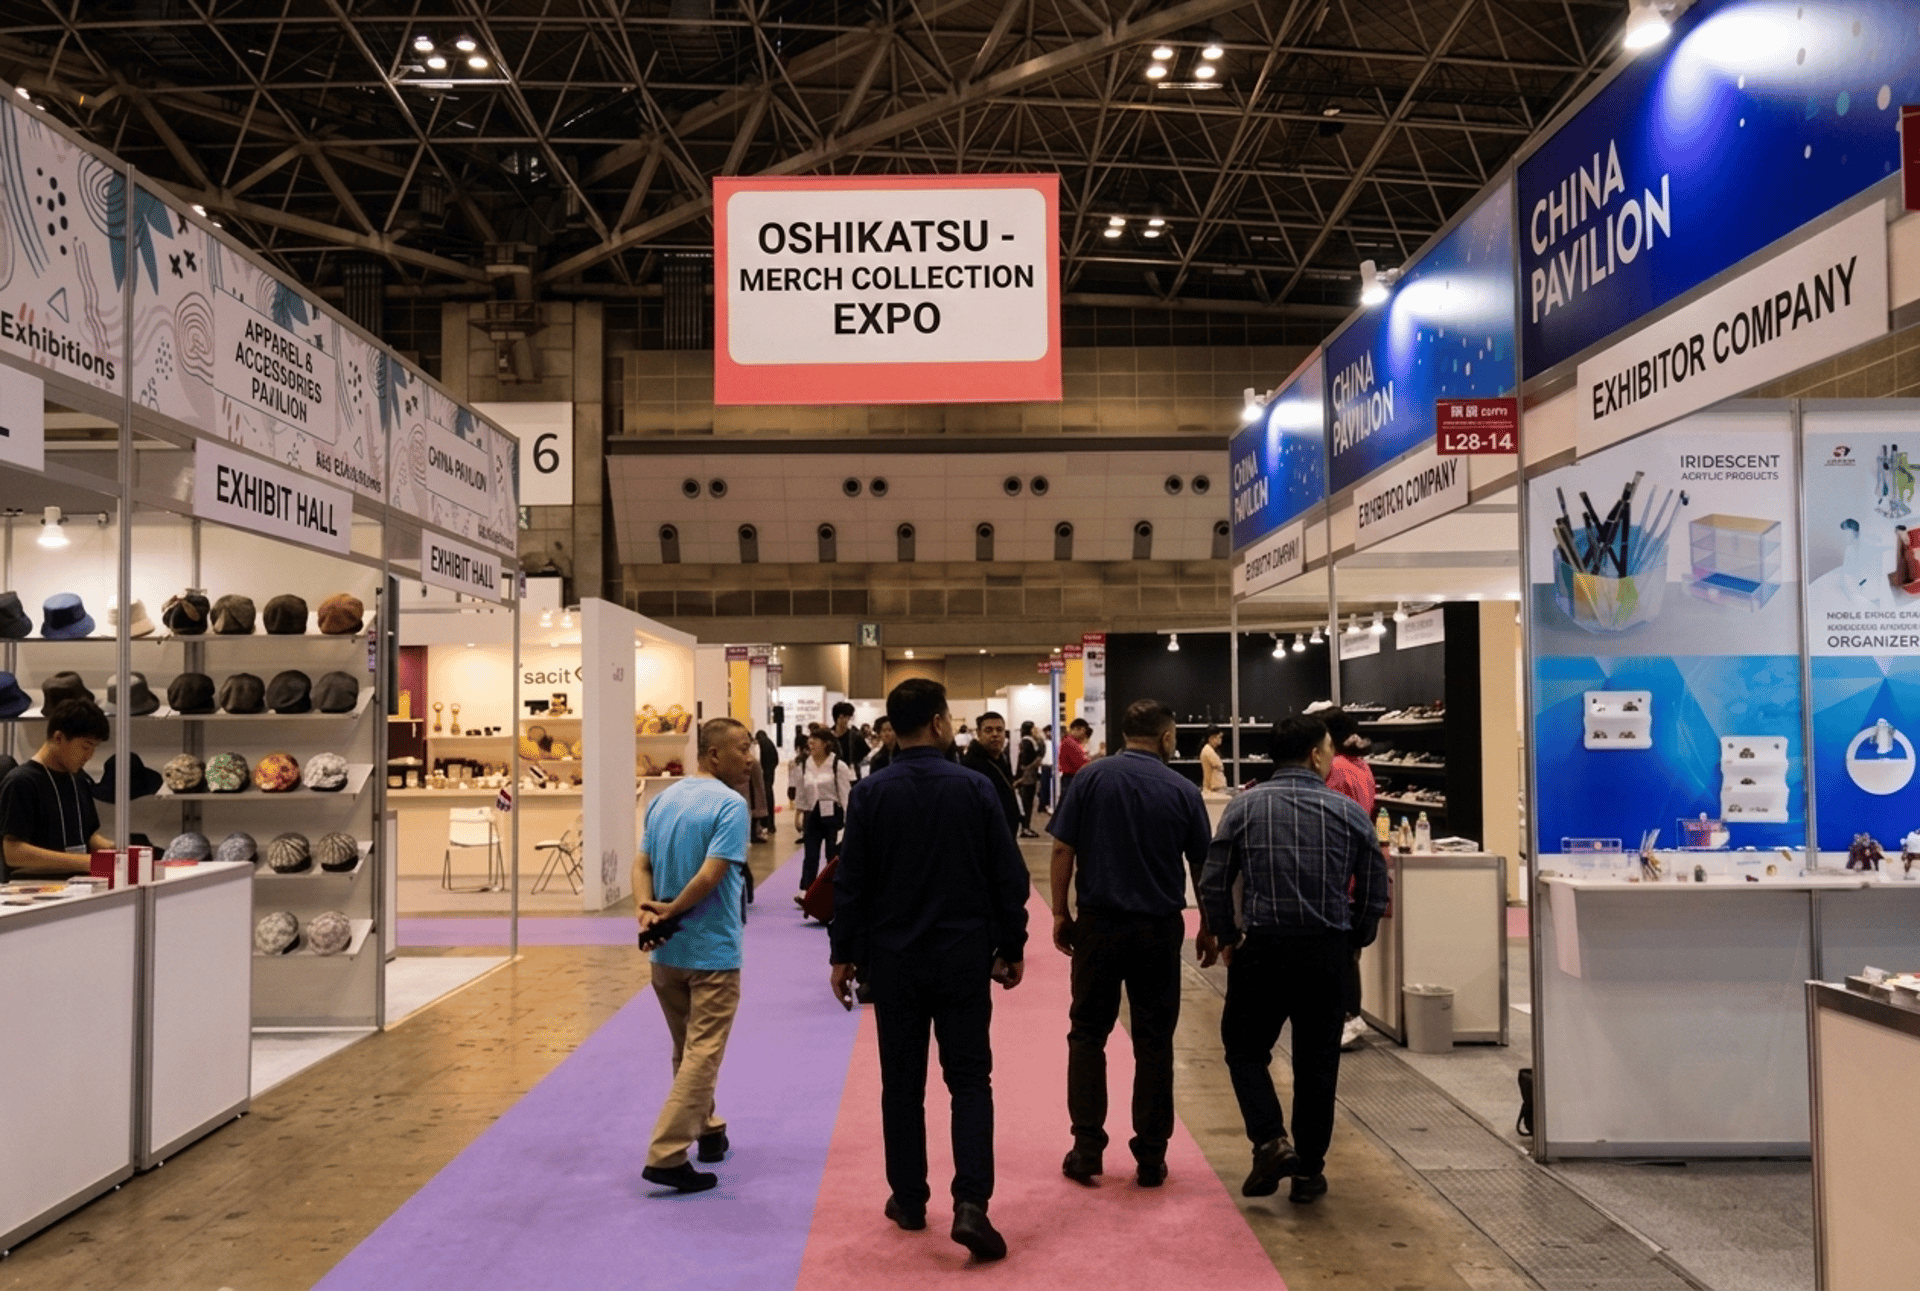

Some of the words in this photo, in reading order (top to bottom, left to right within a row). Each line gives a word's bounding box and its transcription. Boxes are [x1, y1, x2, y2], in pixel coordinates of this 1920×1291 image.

[1531, 139, 1625, 256] CHINA
[758, 220, 989, 254] OSHIKATSU
[1531, 173, 1671, 324] PAVILION
[740, 267, 843, 291] MERCH
[852, 265, 1034, 290] COLLECTION
[834, 302, 941, 335] EXPO
[1593, 333, 1706, 420] EXHIBITOR
[1713, 255, 1858, 364] COMPANY
[1, 310, 115, 380] Exhibitions
[245, 319, 303, 369] APPAREL
[235, 341, 322, 404] ACCESSORIES
[1333, 349, 1374, 413] CHINA
[1333, 380, 1394, 457] PAVILION
[1445, 432, 1514, 450] L28-14
[533, 433, 560, 474] 6
[1680, 455, 1780, 468] IRIDESCENT
[217, 464, 292, 521] EXHIBIT
[297, 492, 337, 536] HALL
[1406, 458, 1458, 507] COMPANY
[431, 546, 470, 582] EXHIBIT
[472, 561, 494, 589] HALL
[1827, 635, 1919, 648] ORGANIZER
[524, 668, 571, 684] sacit
